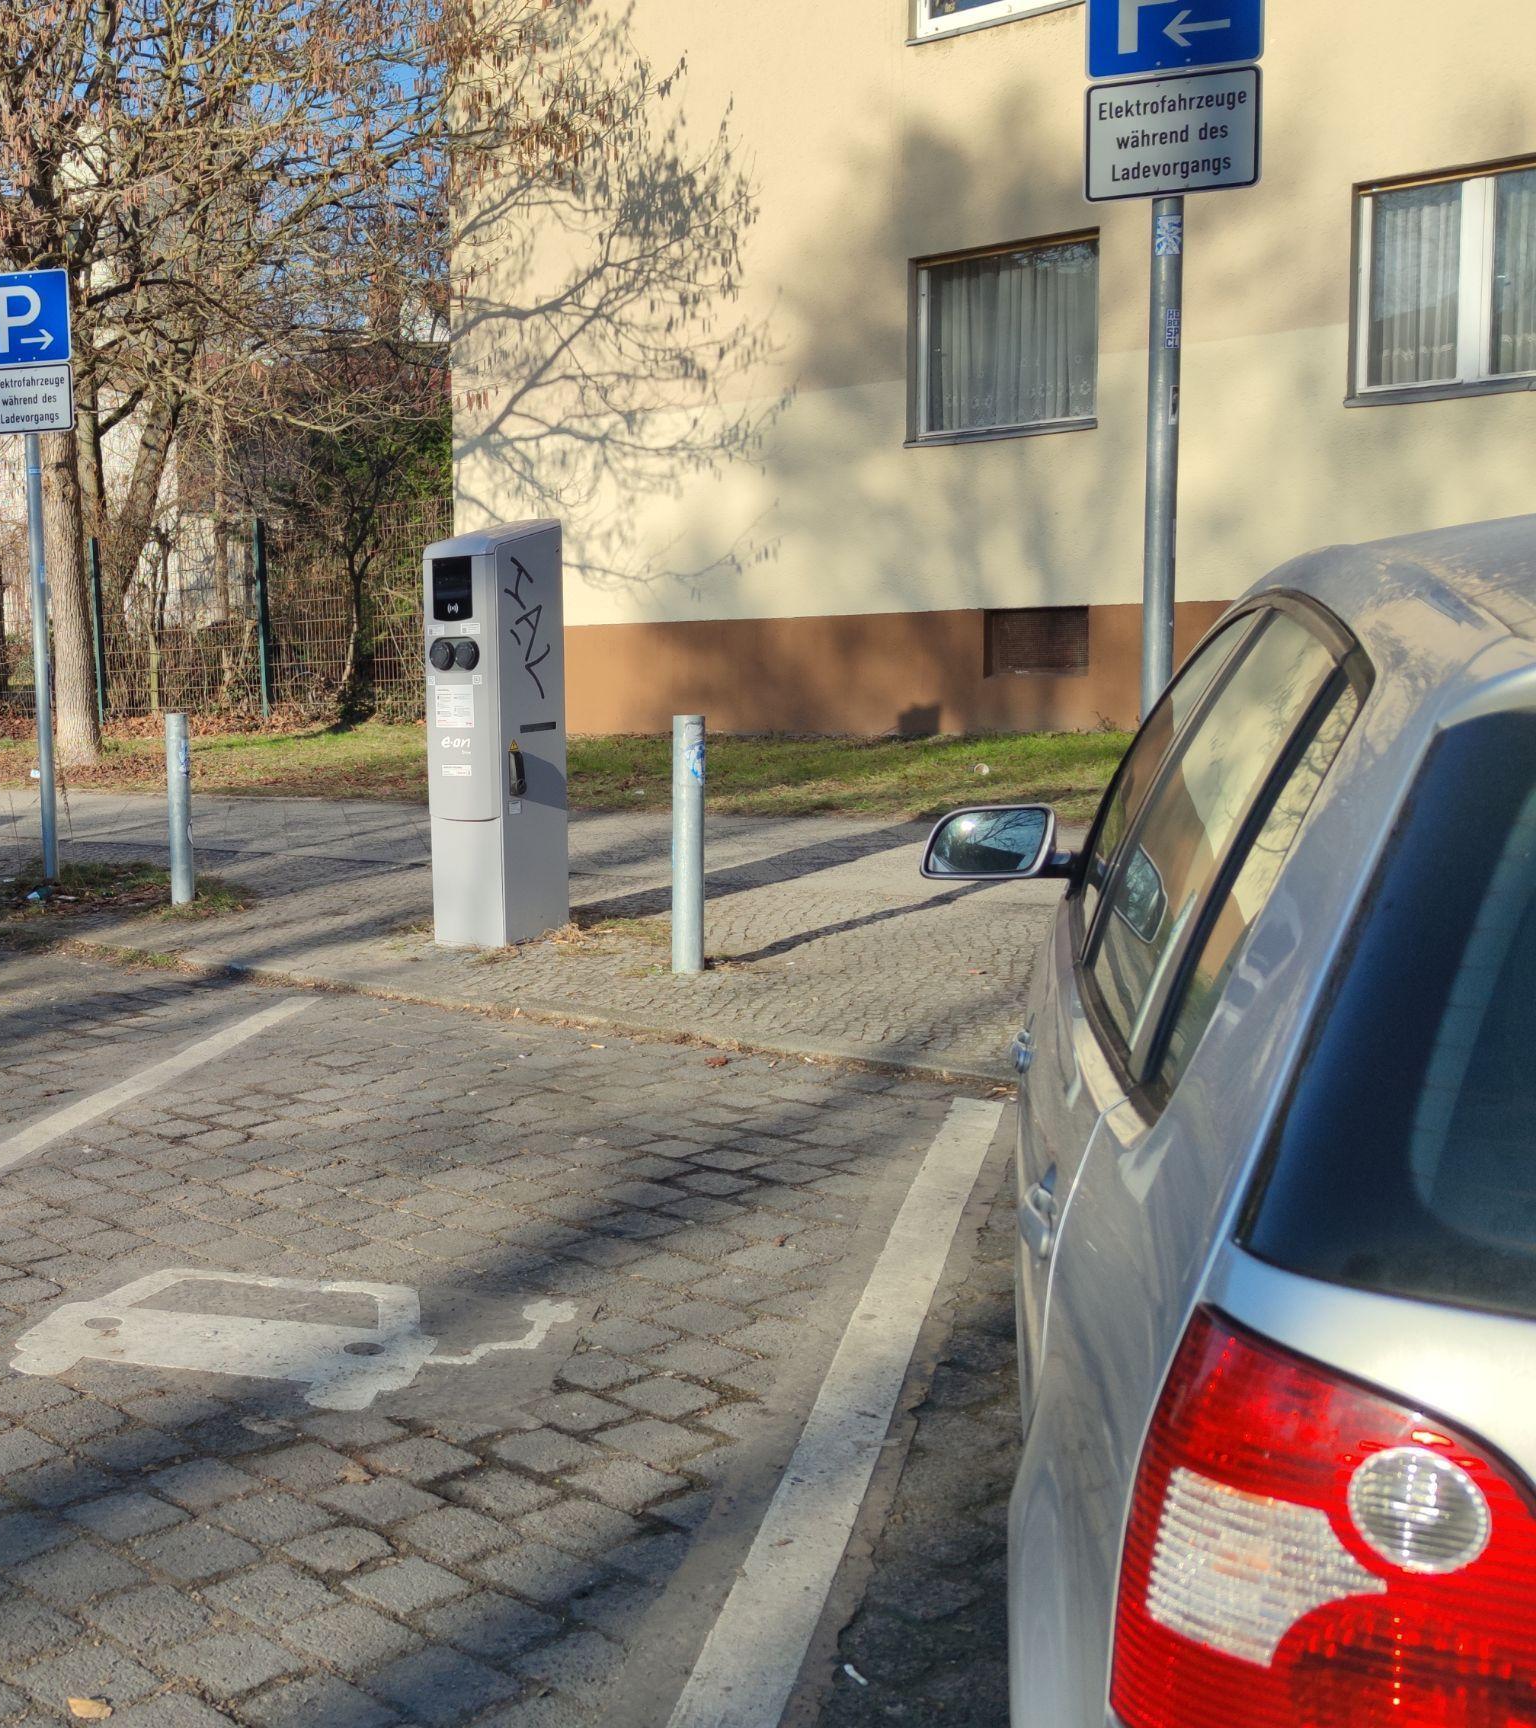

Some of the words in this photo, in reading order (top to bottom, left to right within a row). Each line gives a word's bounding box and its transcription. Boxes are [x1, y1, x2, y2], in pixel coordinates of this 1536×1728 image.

[1098, 89, 1248, 121] Elektrofahrzeuge
[1116, 124, 1189, 150] während
[1198, 122, 1229, 141] des
[1111, 155, 1231, 182] Ladevorgangs
[1, 391, 38, 406] während
[42, 392, 57, 404] des
[0, 411, 60, 425] Ladevorgangs
